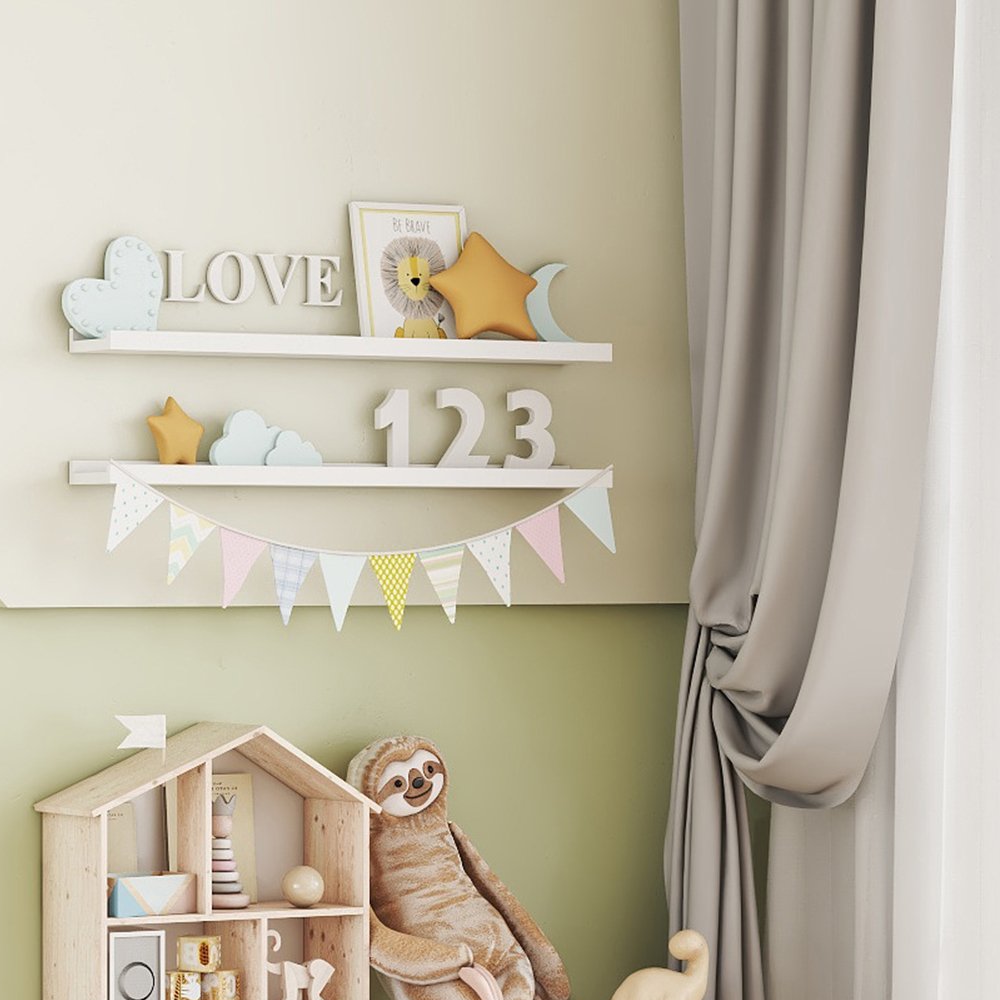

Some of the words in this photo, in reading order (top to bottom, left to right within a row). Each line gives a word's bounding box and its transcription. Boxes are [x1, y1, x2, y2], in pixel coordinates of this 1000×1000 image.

[392, 217, 402, 233] BE
[405, 217, 431, 235] BRAVE
[163, 249, 343, 307] LOVE
